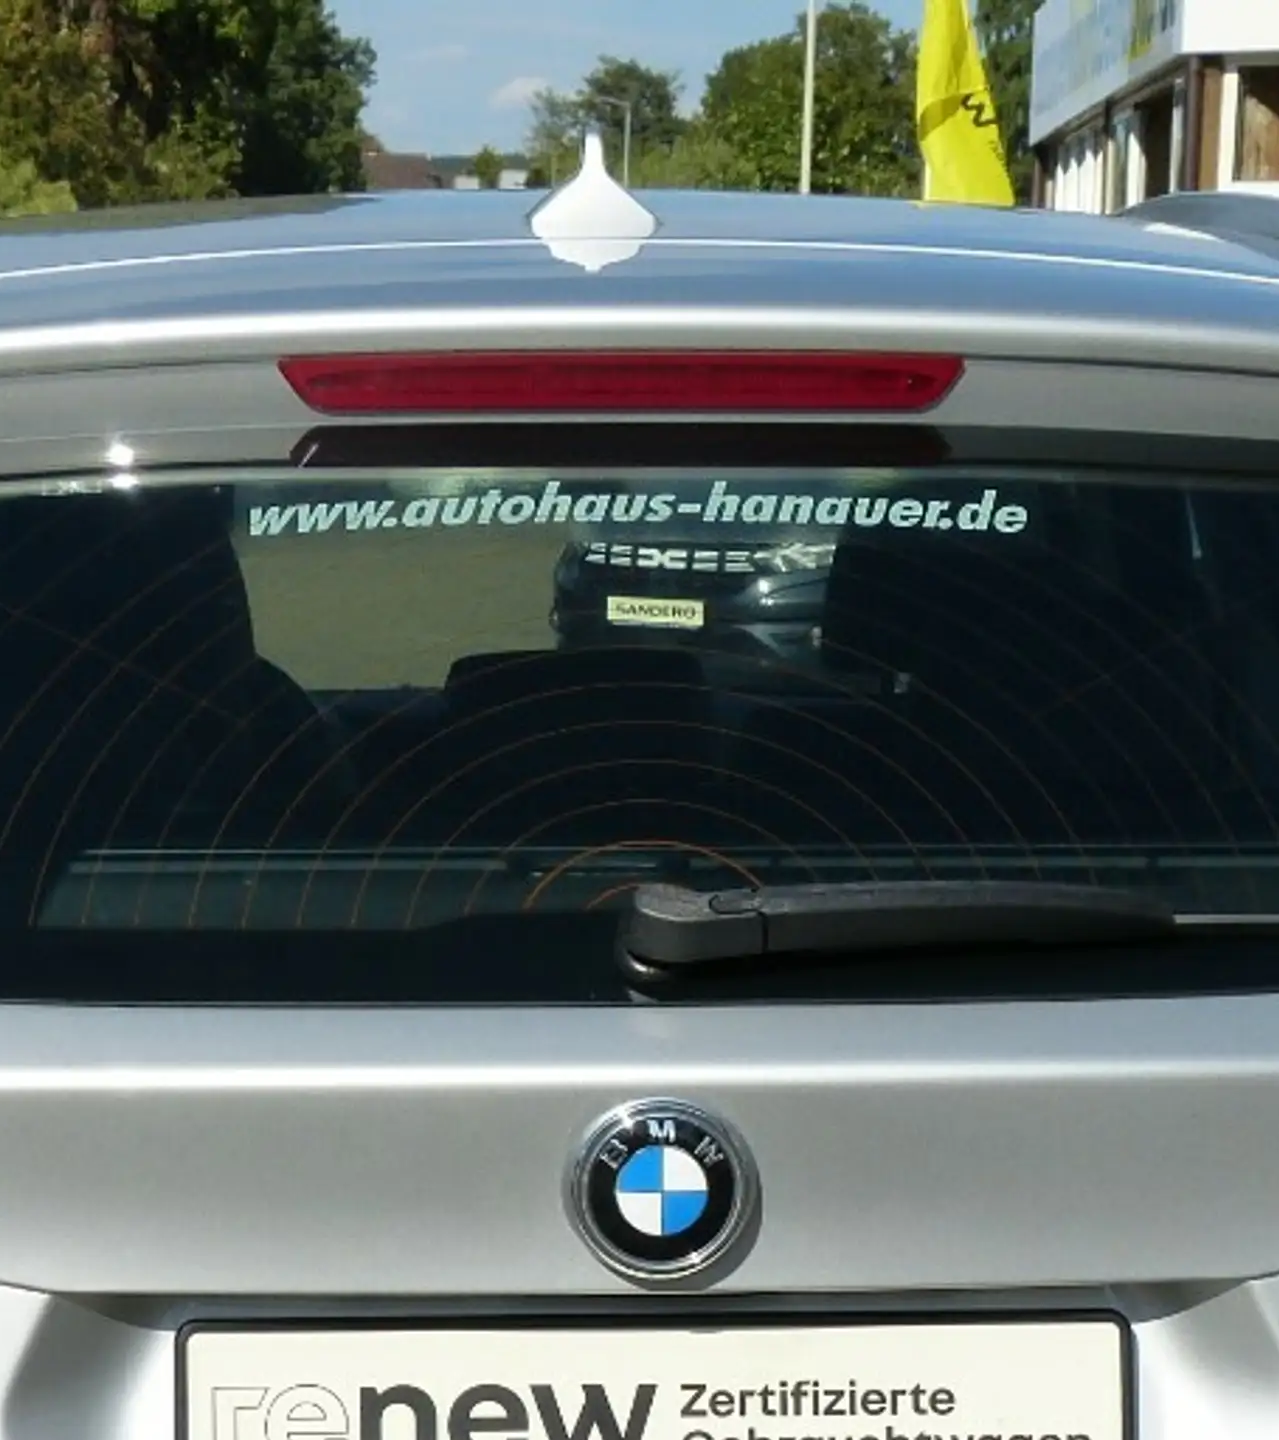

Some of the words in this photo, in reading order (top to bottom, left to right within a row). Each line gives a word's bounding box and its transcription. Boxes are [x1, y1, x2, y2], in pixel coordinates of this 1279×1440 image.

[247, 480, 1029, 536] www.autohaus-hanauer.de
[615, 604, 697, 620] SANDERO
[599, 1119, 724, 1169] BMW
[679, 1379, 957, 1418] Zertifizierte
